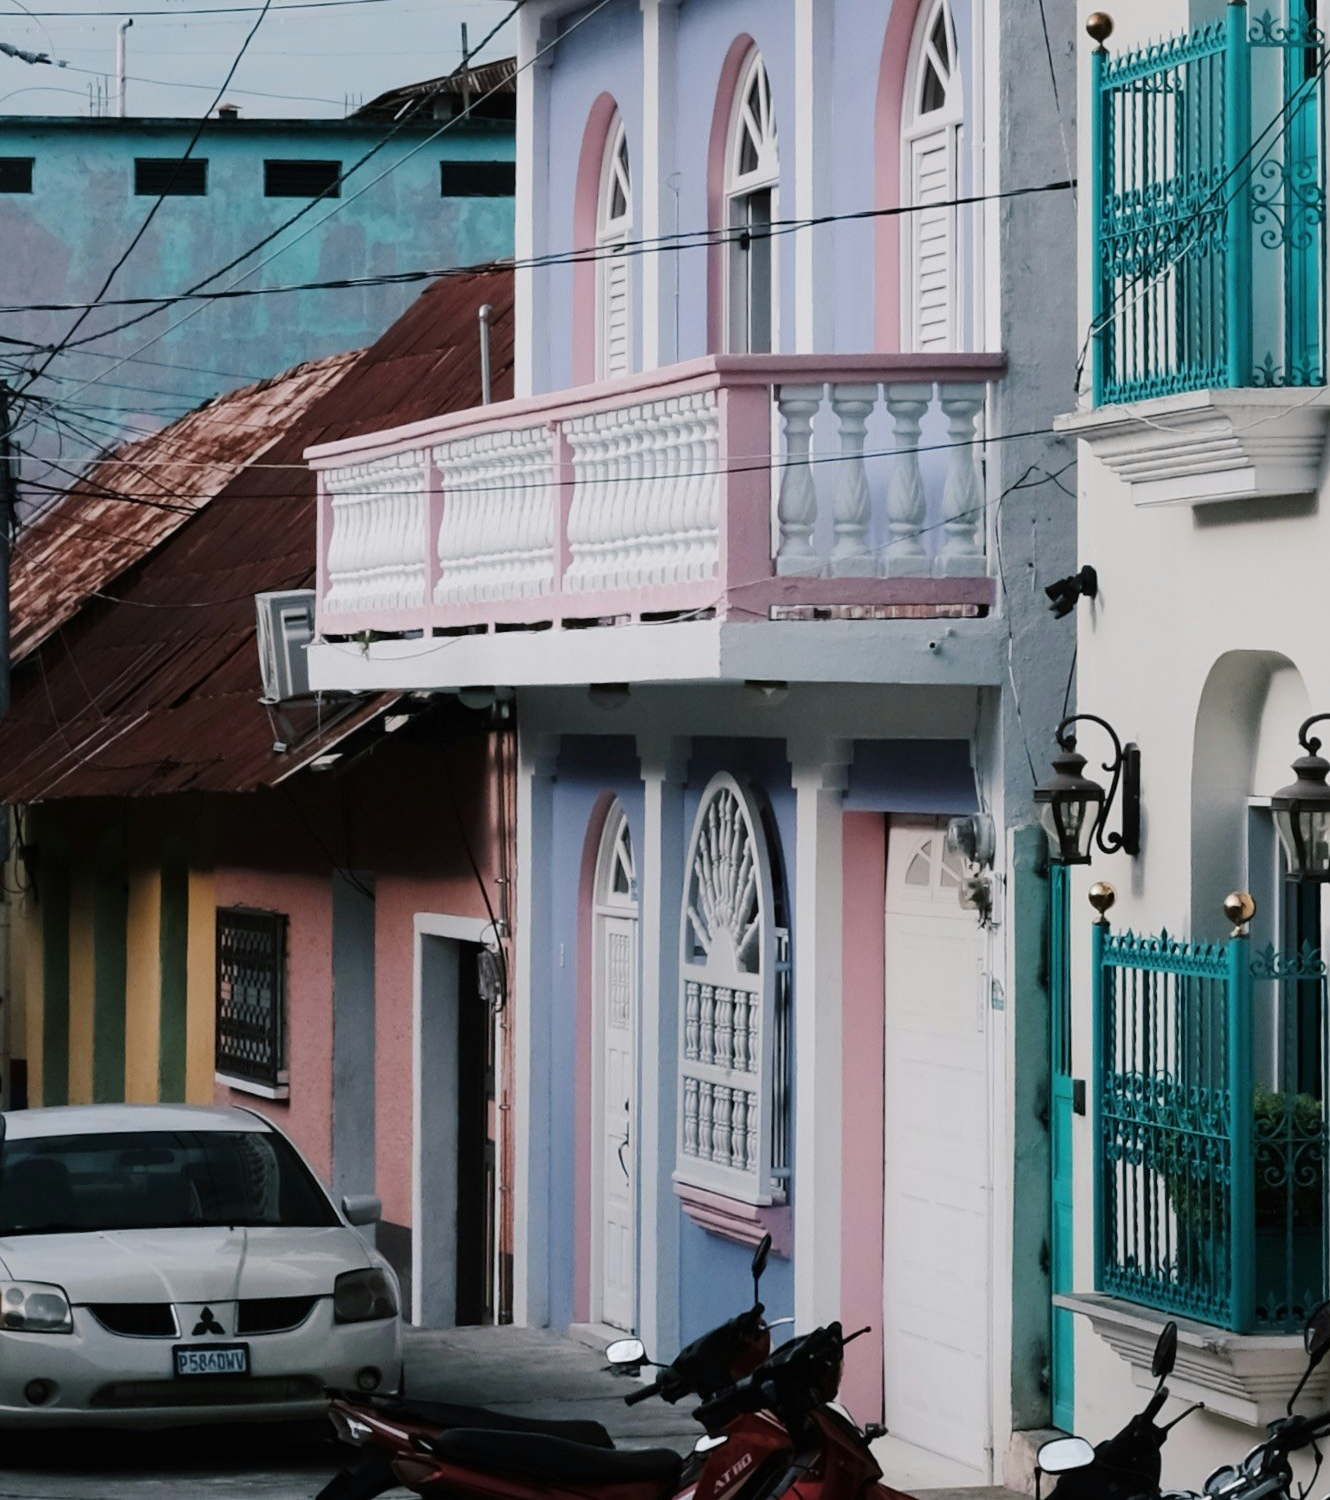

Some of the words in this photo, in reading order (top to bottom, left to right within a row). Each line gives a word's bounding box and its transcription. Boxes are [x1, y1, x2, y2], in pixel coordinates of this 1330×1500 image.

[179, 1351, 245, 1372] P586DWV
[713, 1469, 732, 1495] AT
[732, 1452, 752, 1476] 110
